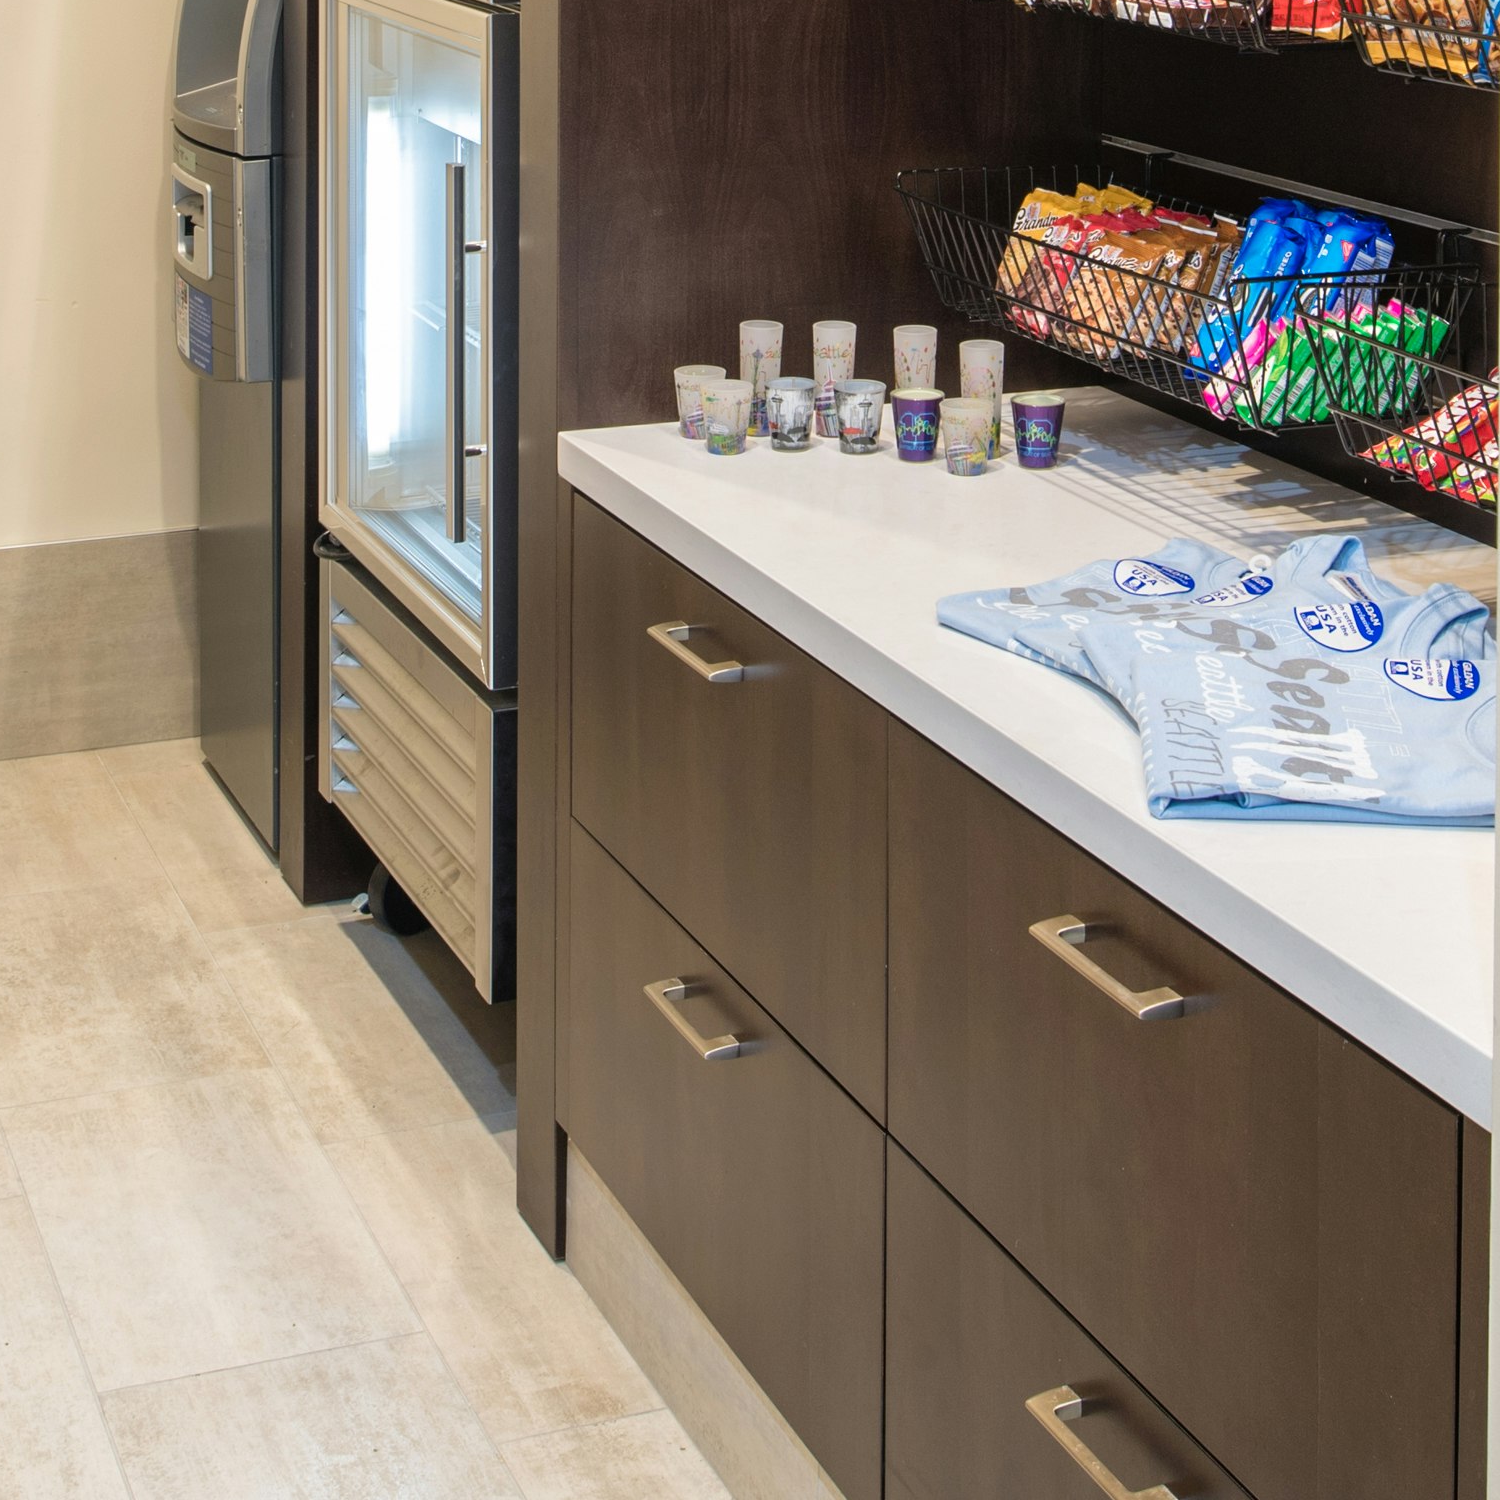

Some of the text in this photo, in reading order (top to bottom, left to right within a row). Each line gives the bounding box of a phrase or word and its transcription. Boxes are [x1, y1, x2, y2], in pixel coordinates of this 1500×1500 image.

[1013, 208, 1060, 231] Grandm
[1131, 568, 1158, 587] USA
[1213, 590, 1229, 602] SA
[1315, 605, 1337, 634] USA
[1340, 622, 1350, 637] the
[1342, 610, 1358, 634] cotton
[1410, 660, 1424, 681] USA
